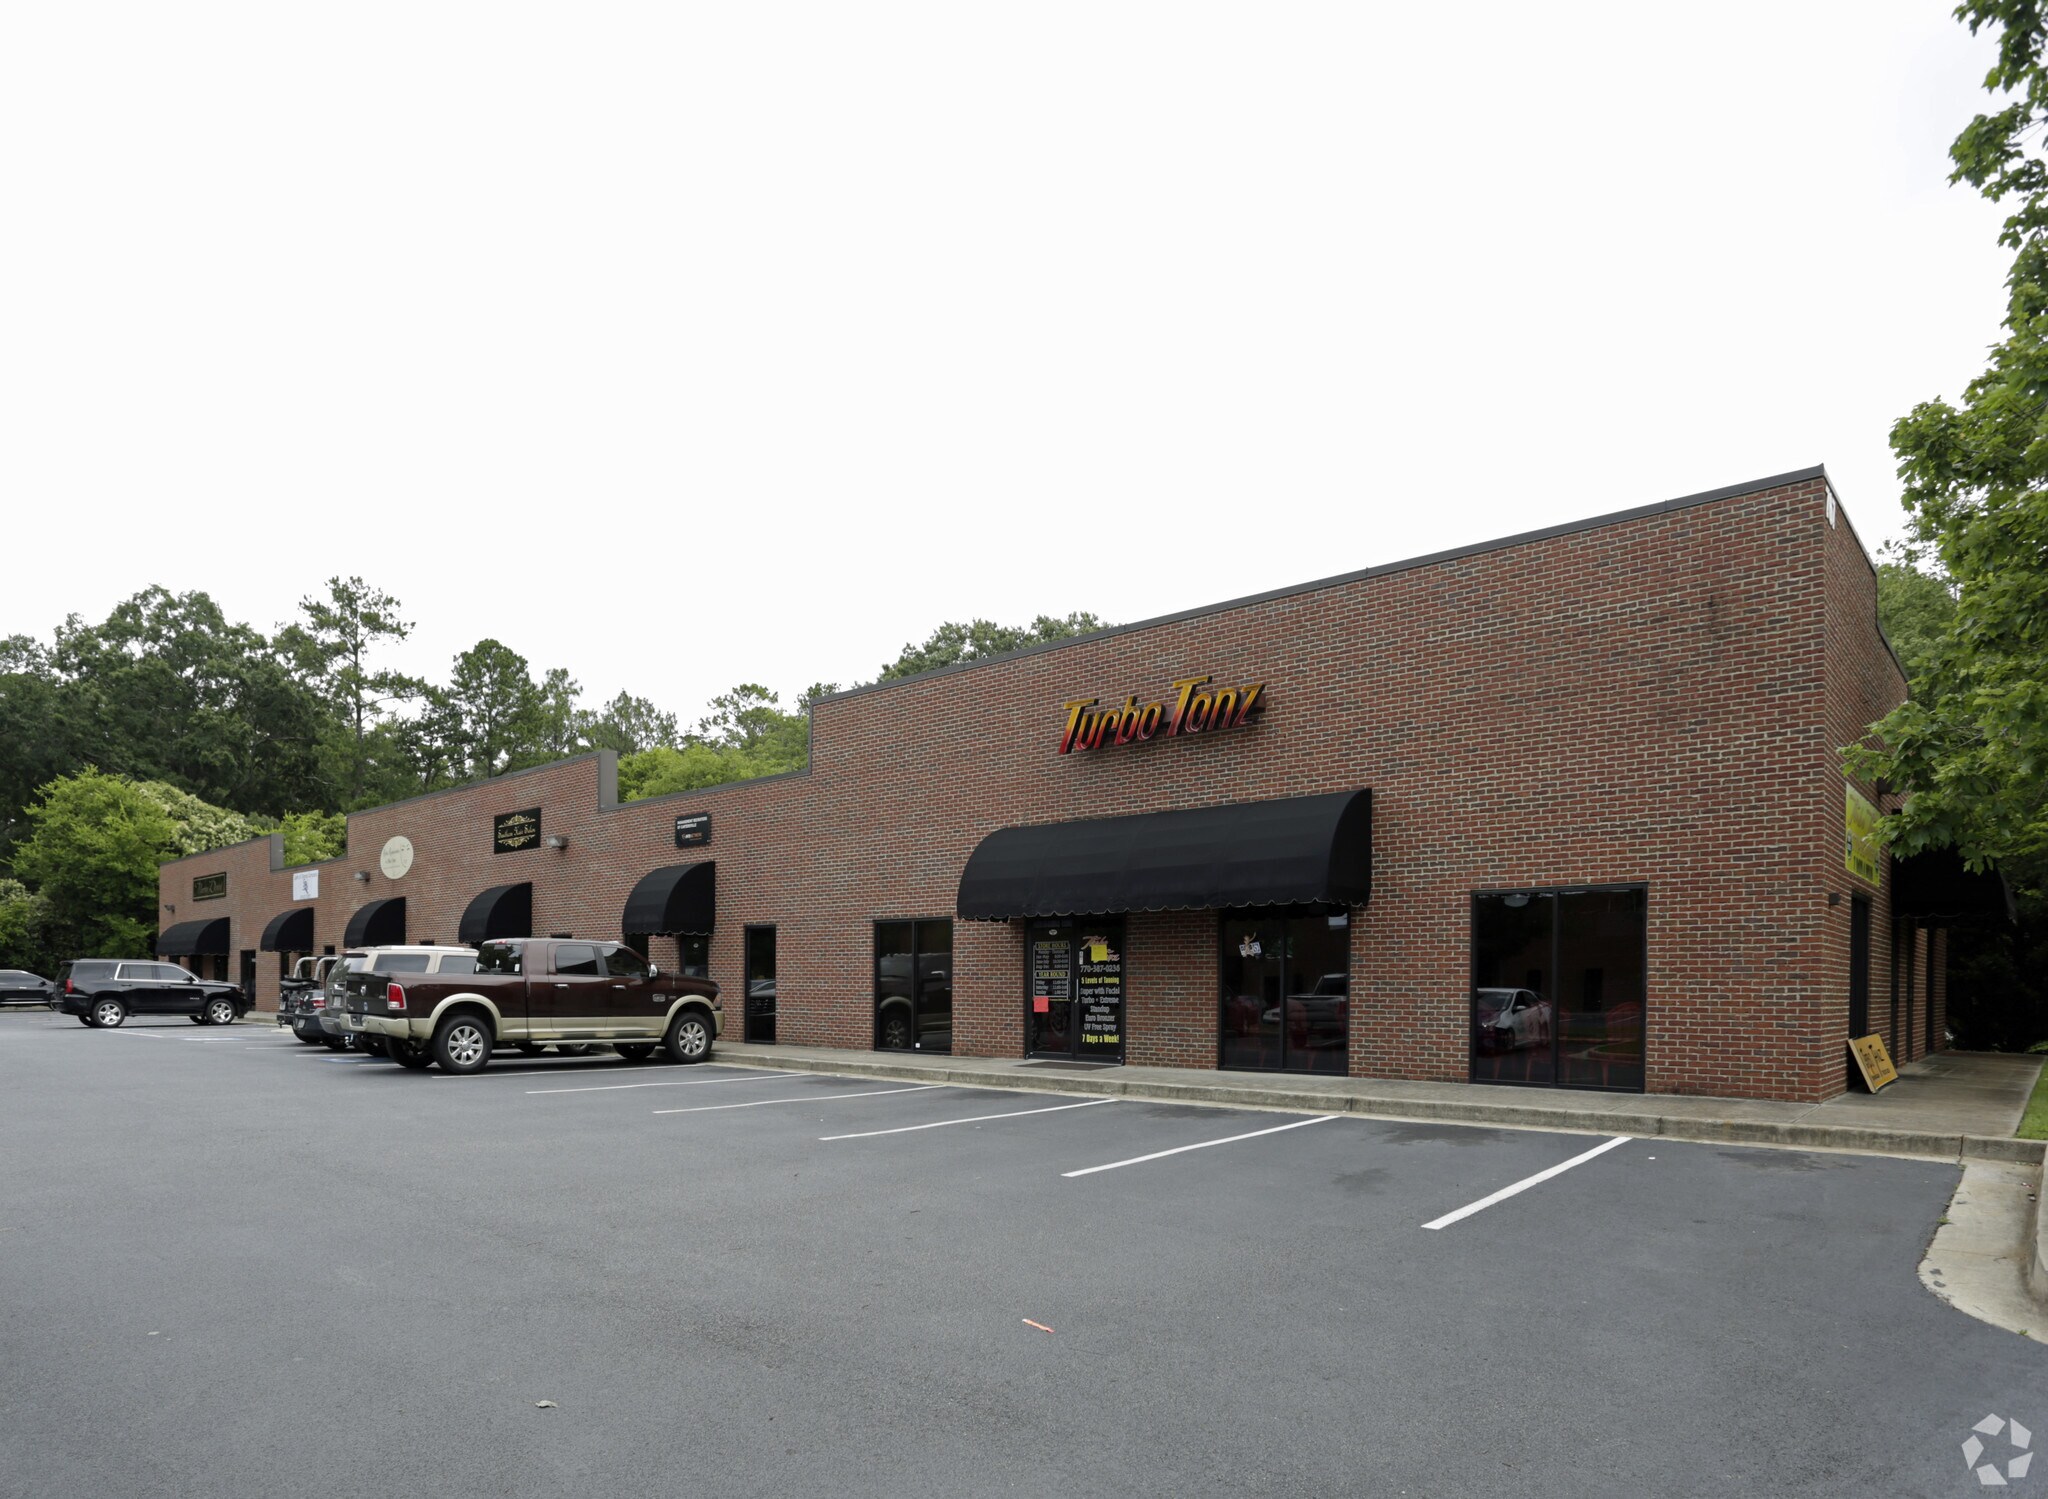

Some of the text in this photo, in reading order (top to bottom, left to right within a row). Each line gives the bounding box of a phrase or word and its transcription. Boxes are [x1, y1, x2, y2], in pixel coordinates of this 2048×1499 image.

[1059, 675, 1266, 754] Turbo Tanz
[1085, 976, 1098, 984] Levels
[1103, 976, 1120, 985] Tanning
[1094, 986, 1105, 995] with
[1105, 986, 1120, 995] Facial
[1091, 1023, 1102, 1031] Free
[1086, 1033, 1099, 1044] Days
